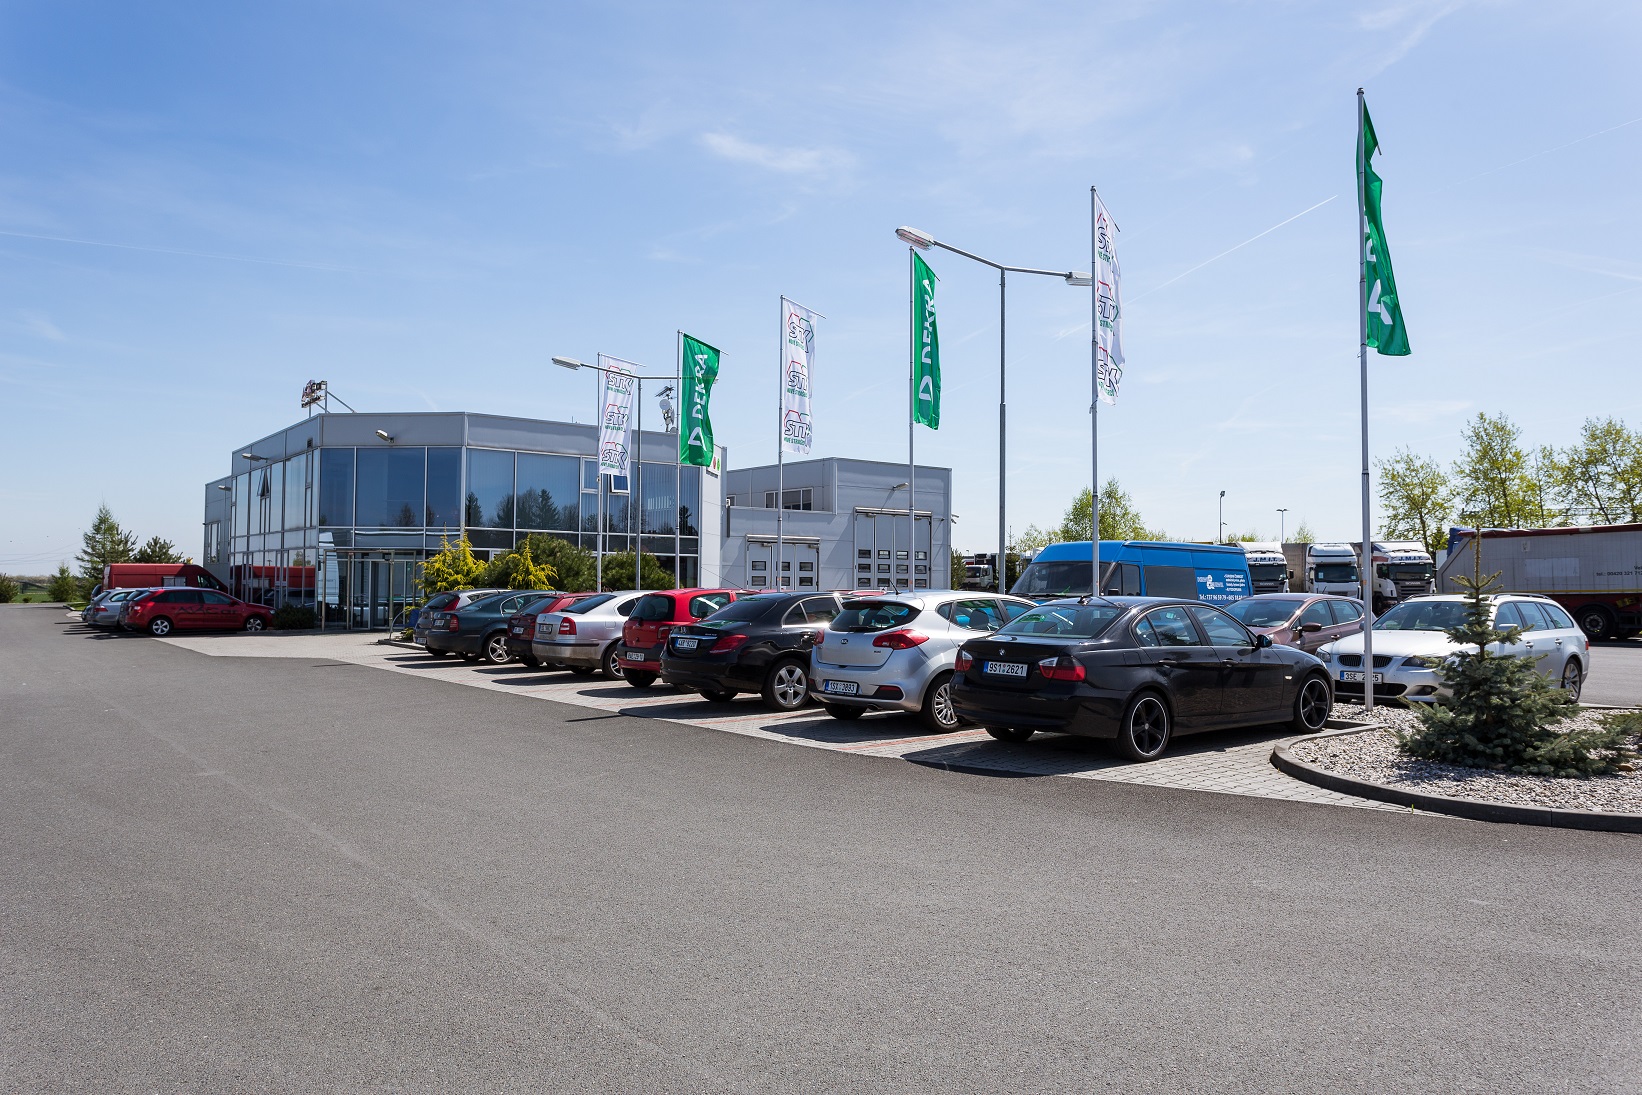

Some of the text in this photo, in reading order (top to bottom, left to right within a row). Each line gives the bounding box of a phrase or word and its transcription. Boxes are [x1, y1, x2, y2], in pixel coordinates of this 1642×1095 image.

[608, 373, 632, 395] STK
[692, 354, 708, 420] DEKRA
[602, 449, 626, 470] STK
[989, 662, 1024, 675] 9S1 2621
